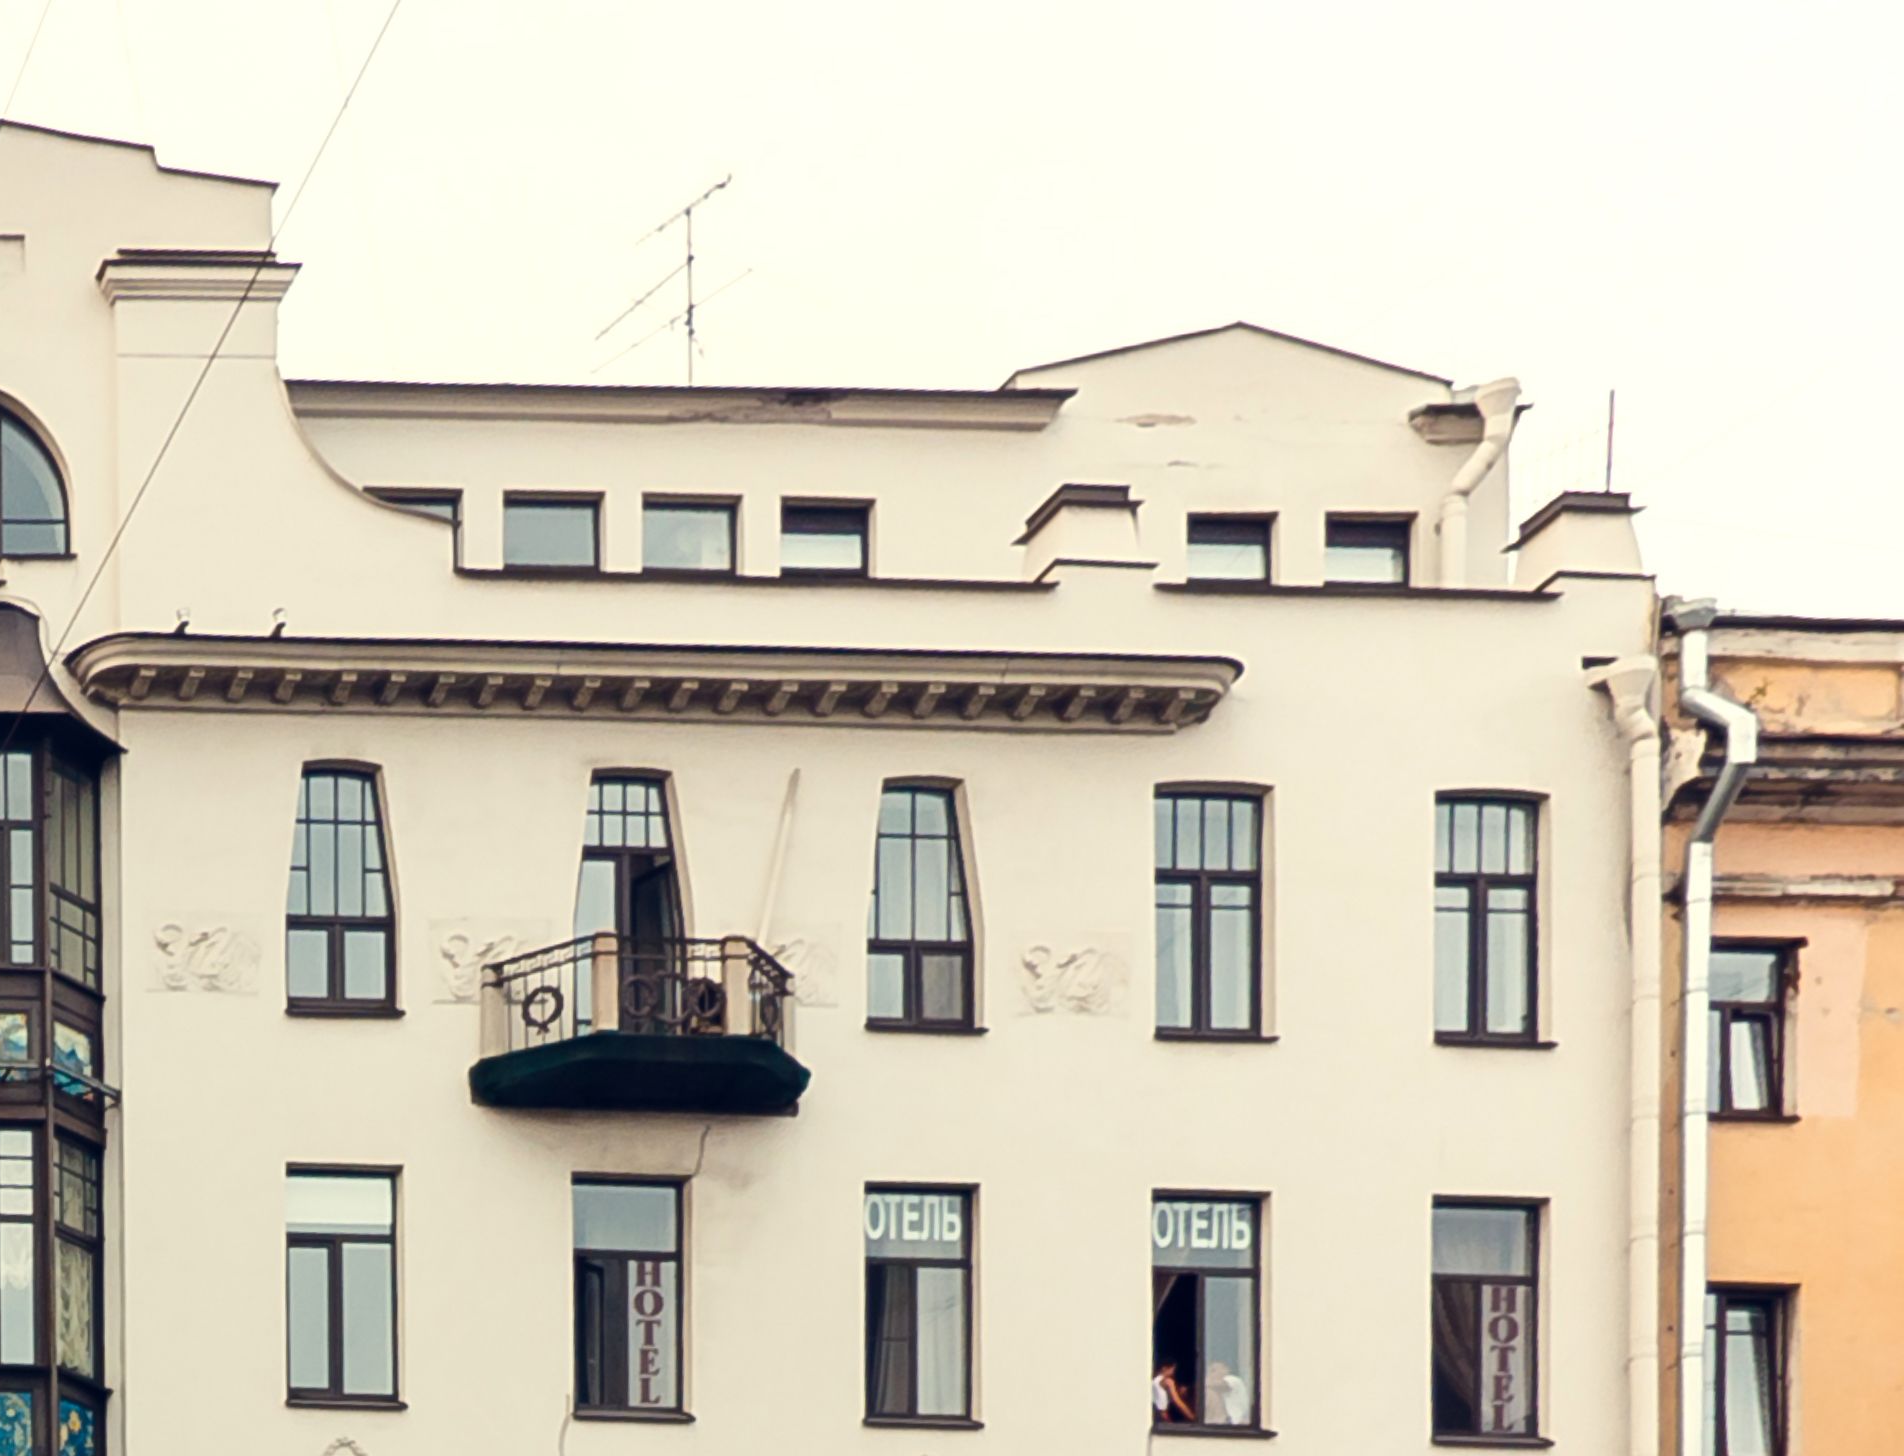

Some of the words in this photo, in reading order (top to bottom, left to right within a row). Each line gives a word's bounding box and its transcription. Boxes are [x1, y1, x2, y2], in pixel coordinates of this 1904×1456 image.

[864, 1194, 962, 1241] ОТЕЛЬ
[1153, 1201, 1252, 1250] ОТЕЛЬ
[633, 1261, 665, 1405] HOTEL
[1487, 1286, 1519, 1431] HOTEL
